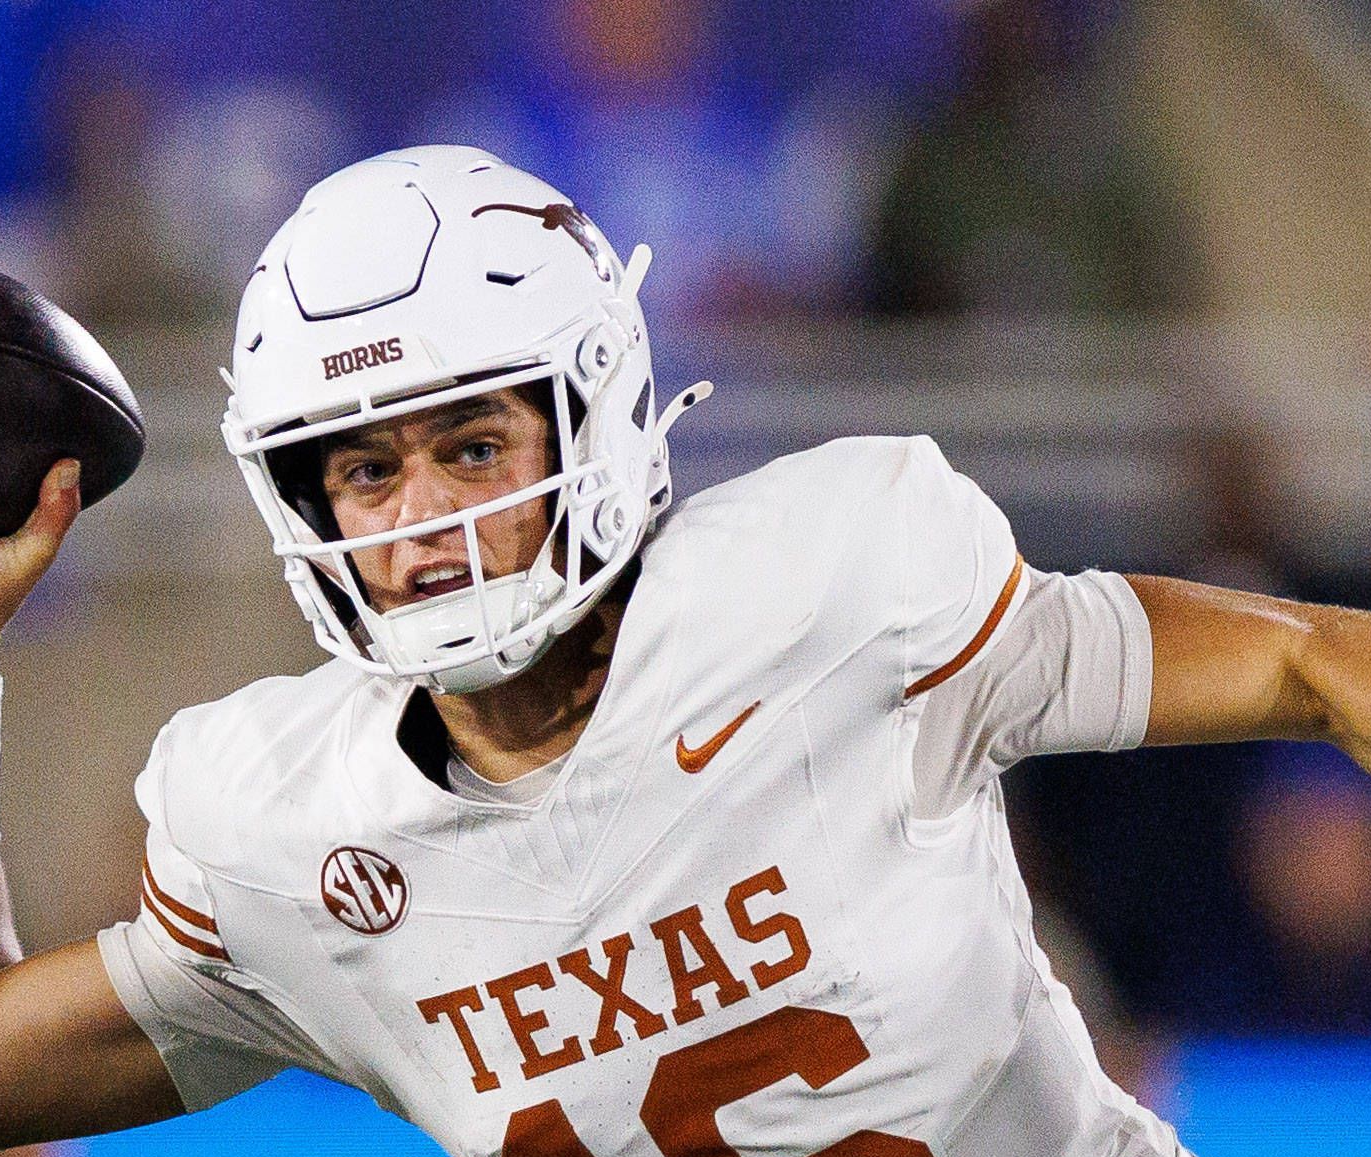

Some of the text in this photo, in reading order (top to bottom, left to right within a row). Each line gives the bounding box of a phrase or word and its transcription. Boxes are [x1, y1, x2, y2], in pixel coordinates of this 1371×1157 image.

[321, 336, 404, 380] HORNS
[321, 847, 407, 934] SEC
[416, 864, 812, 1093] TEXAS
